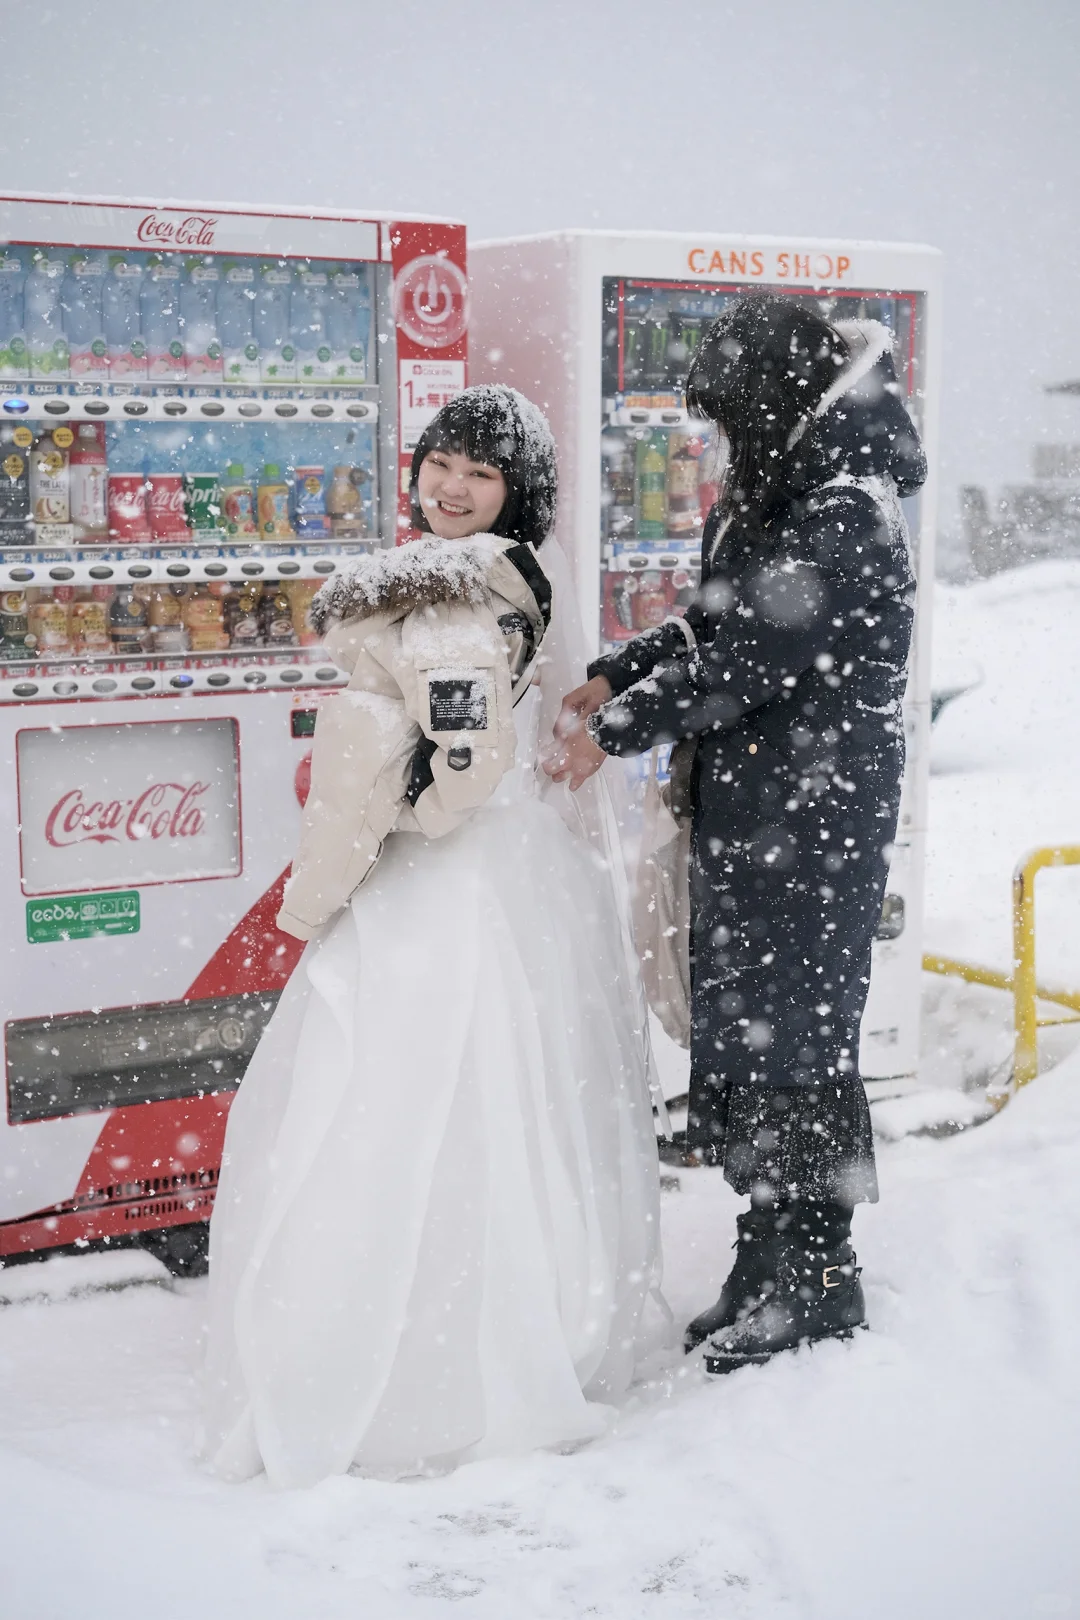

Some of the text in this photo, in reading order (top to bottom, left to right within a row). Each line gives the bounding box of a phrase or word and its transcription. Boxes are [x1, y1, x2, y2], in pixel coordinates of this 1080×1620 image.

[687, 248, 852, 279] CANS SHOP
[45, 781, 212, 848] Coca-Cola
